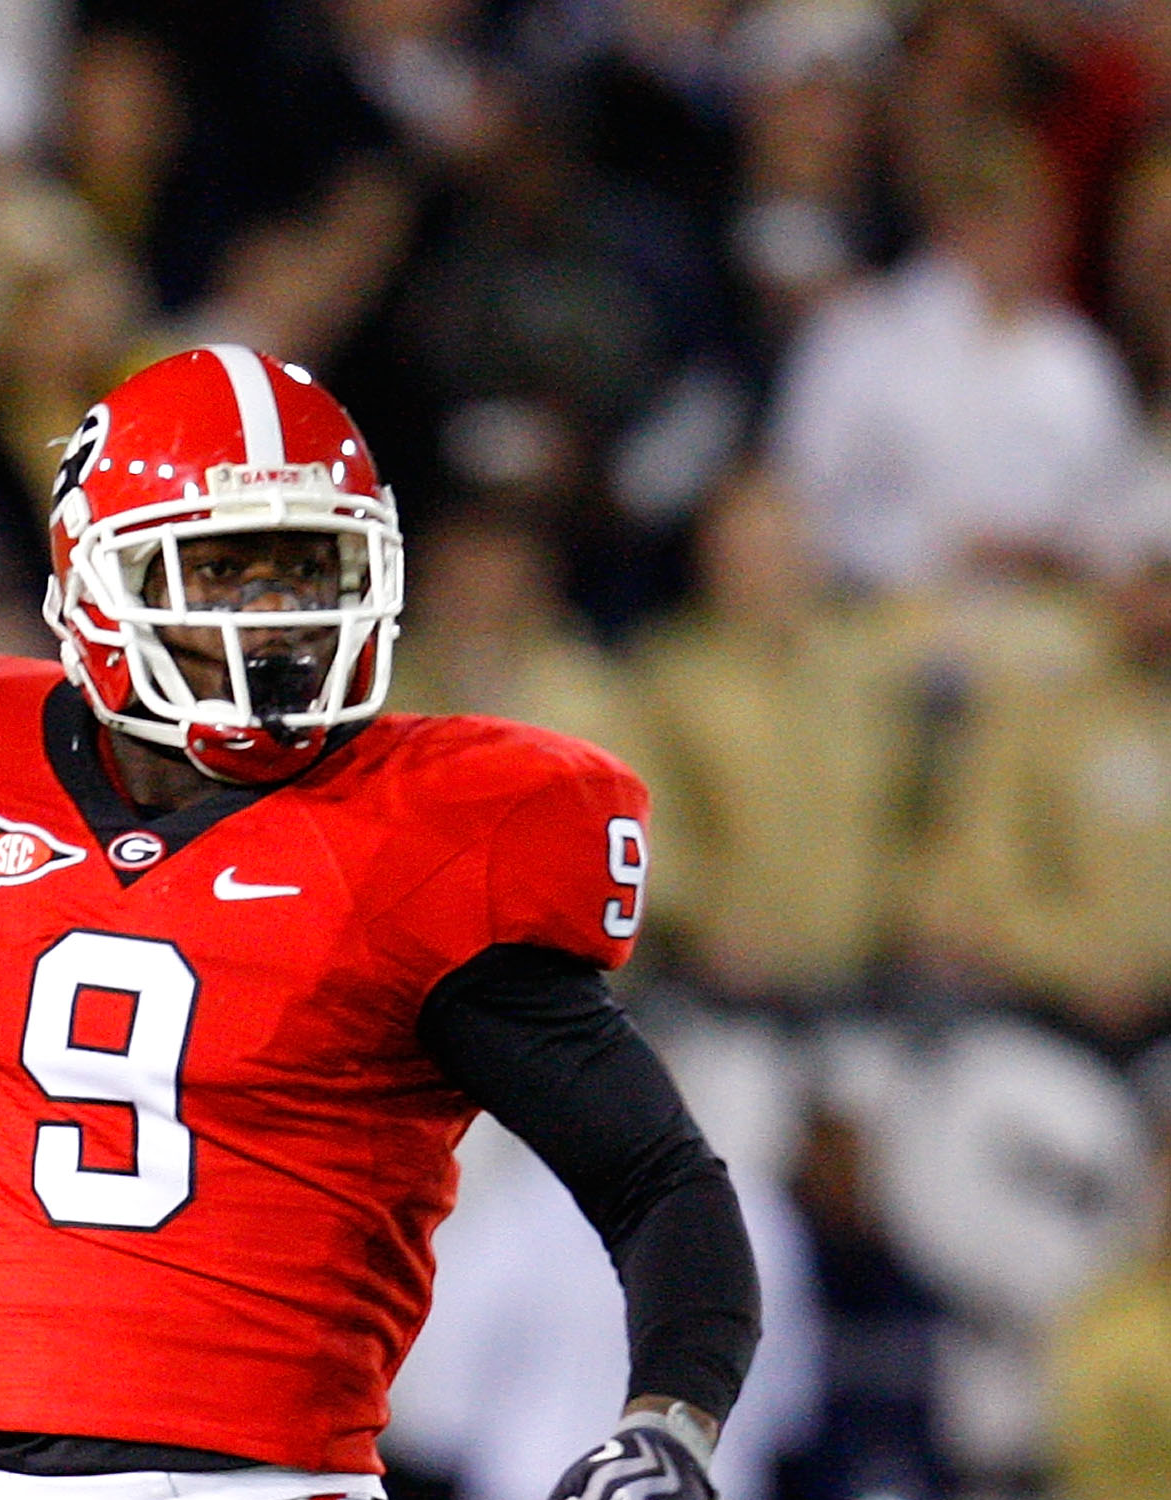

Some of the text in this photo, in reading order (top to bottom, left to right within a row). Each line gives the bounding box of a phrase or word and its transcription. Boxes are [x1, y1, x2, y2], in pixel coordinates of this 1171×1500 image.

[113, 836, 163, 864] G
[603, 816, 648, 938] 9
[22, 929, 200, 1231] 9
